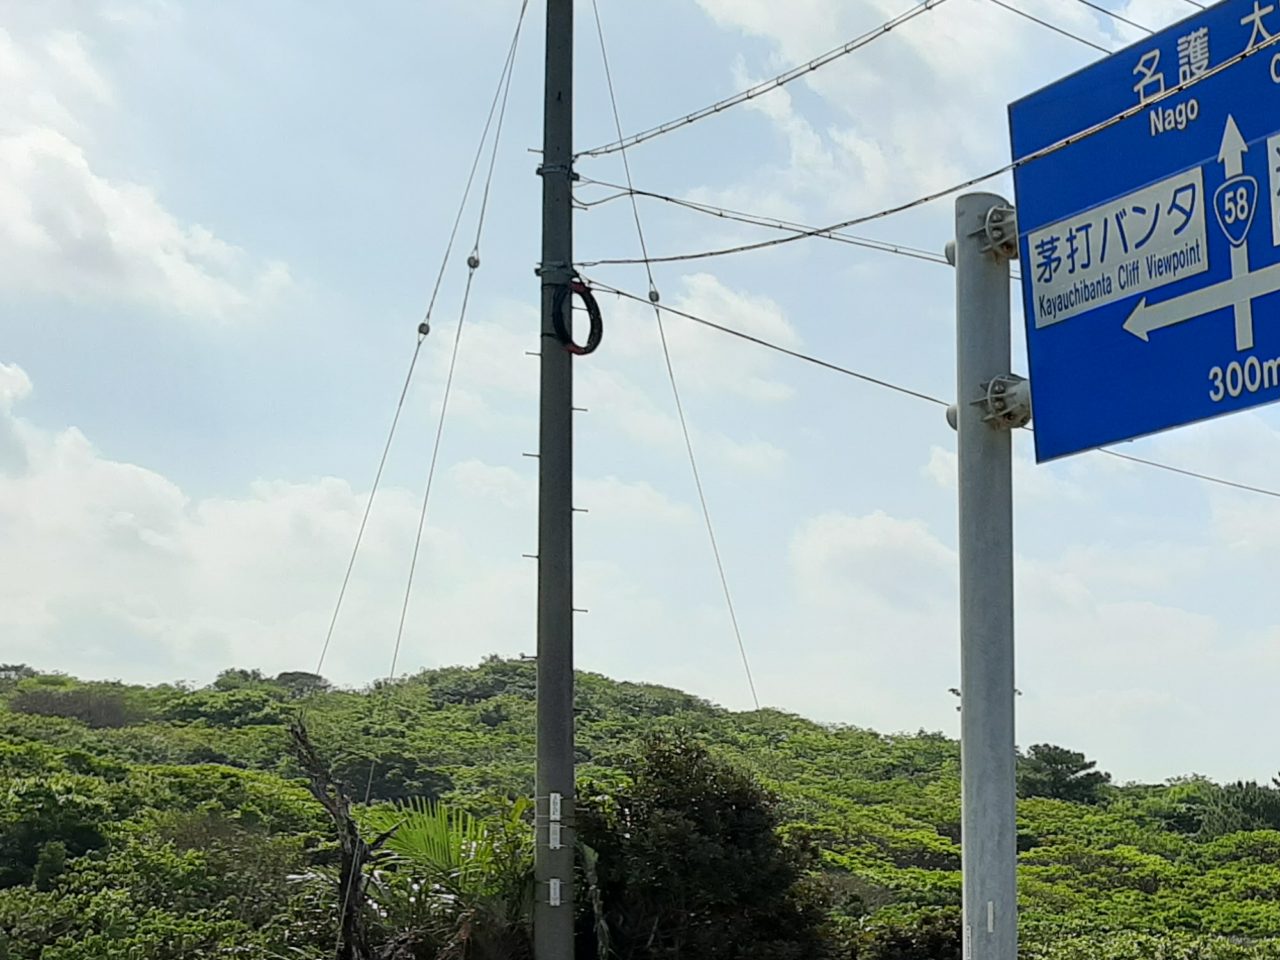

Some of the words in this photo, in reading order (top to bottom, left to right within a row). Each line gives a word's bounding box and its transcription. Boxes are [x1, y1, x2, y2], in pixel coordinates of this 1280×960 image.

[1133, 27, 1209, 107] 名護
[1149, 98, 1199, 137] Nago
[1035, 183, 1196, 284] 茅打バンタ
[1224, 186, 1249, 224] 58
[1038, 272, 1113, 320] Kayauchibanta
[1117, 259, 1141, 290] Cliff
[1145, 238, 1202, 280] Viewpoint
